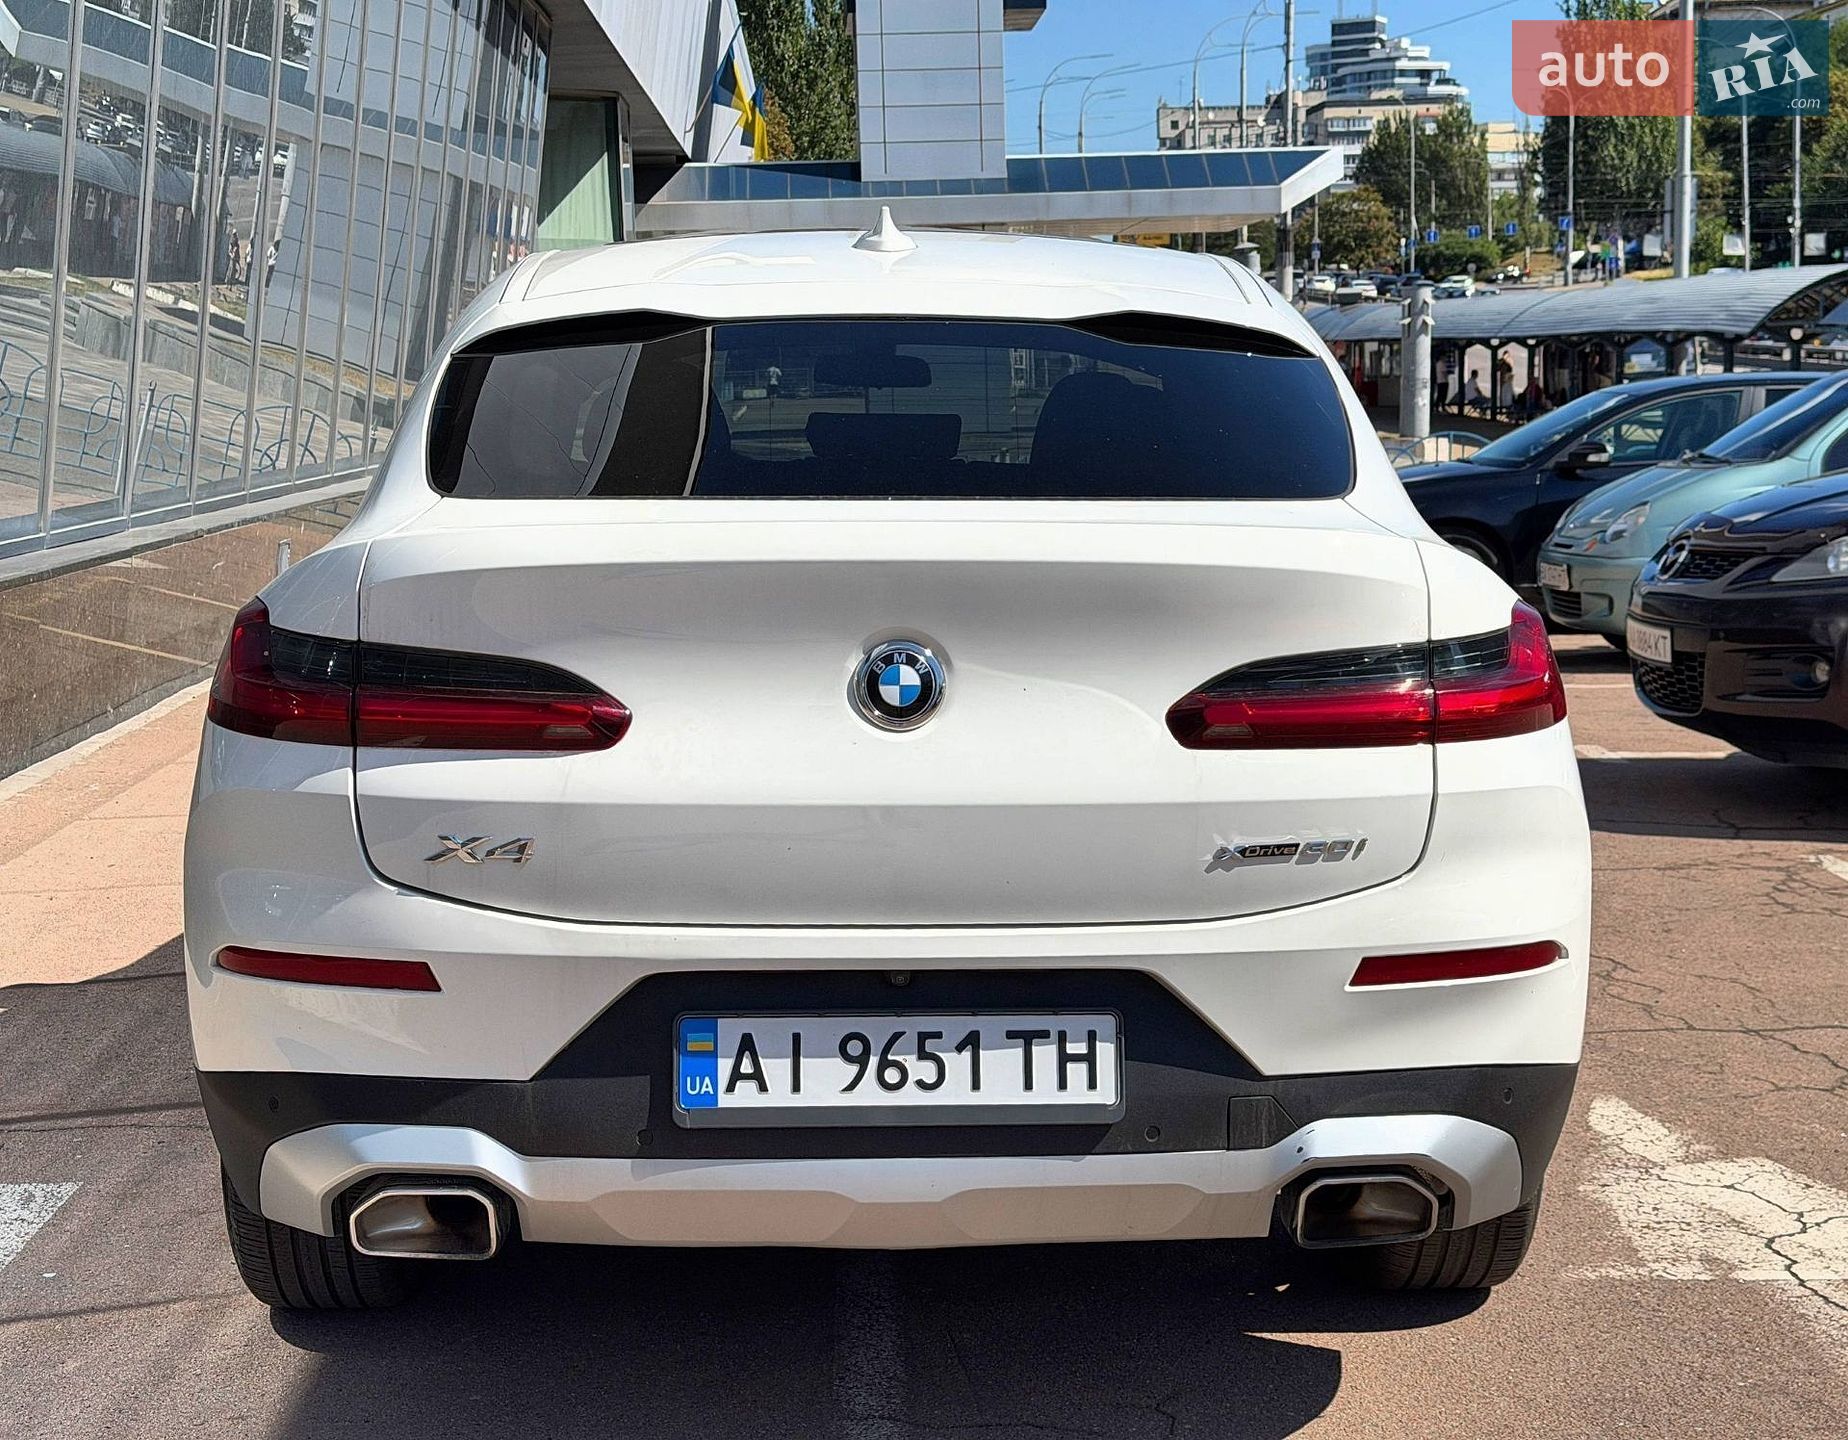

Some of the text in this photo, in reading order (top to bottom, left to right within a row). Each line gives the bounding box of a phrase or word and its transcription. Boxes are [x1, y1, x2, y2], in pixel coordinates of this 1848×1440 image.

[871, 652, 929, 675] BMW
[423, 834, 536, 866] X4
[724, 1029, 1098, 1095] AI 9651 TH
[686, 1078, 714, 1095] UA
